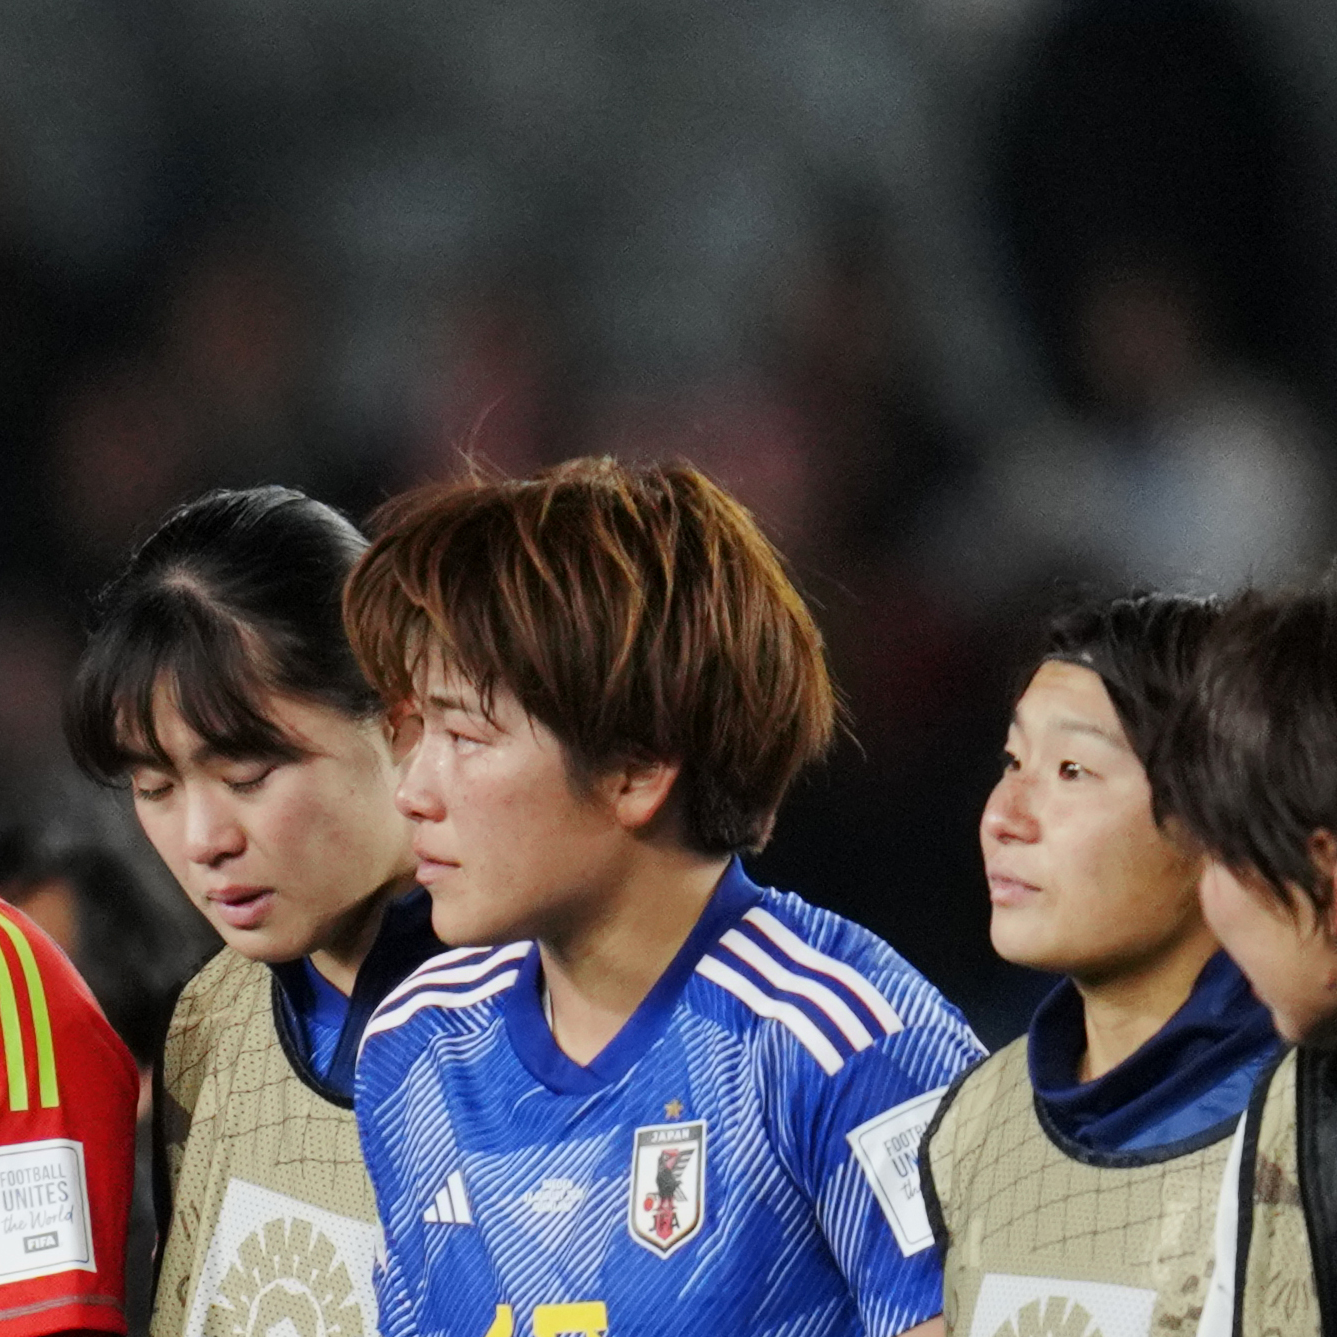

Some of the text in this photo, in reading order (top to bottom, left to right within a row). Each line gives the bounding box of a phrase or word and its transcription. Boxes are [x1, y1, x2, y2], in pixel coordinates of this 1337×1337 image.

[650, 1128, 690, 1143] JAPAN
[0, 1163, 67, 1188] FOOTBALL
[2, 1180, 69, 1212] UNITES
[1, 1204, 75, 1234] the World
[648, 1212, 680, 1232] JFA
[25, 1234, 57, 1252] FIFA
